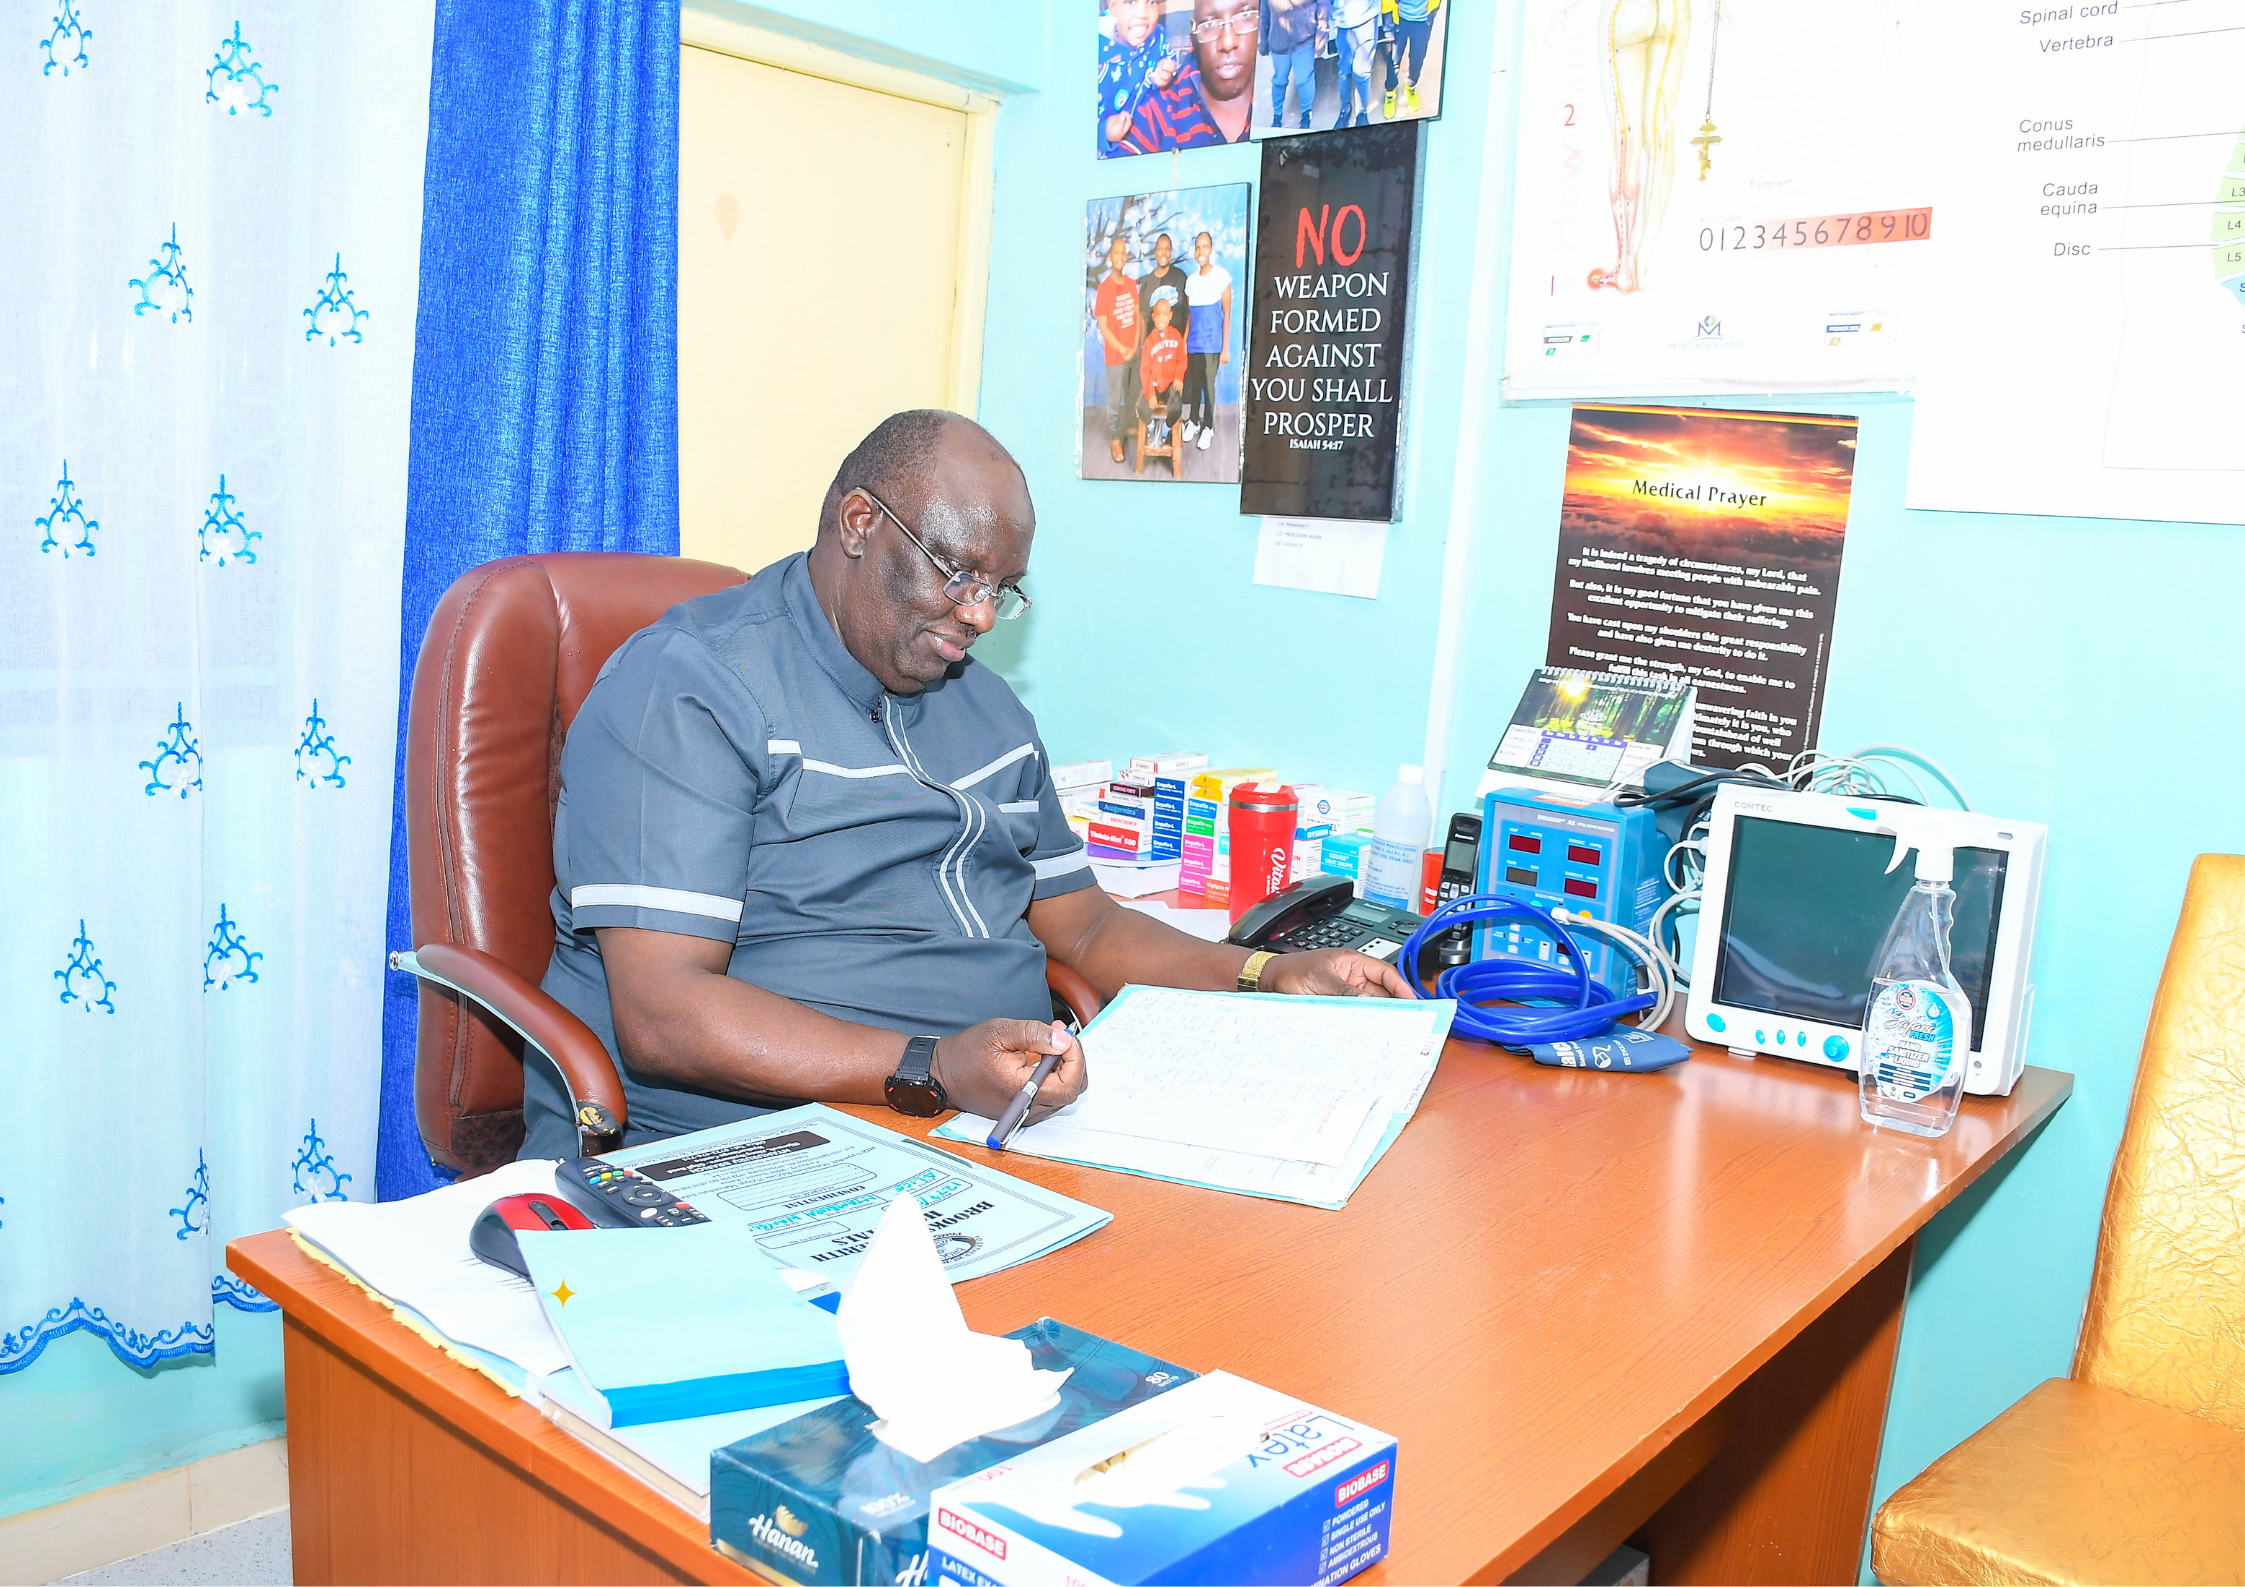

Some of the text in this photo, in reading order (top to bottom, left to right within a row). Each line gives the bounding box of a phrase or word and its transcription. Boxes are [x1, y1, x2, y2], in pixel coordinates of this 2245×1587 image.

[2020, 1, 2118, 26] Spinal cord
[2039, 35, 2114, 53] Vertebra
[1563, 103, 1576, 127] 2
[2019, 119, 2073, 133] Conus
[2017, 134, 2106, 152] medullaris
[1749, 178, 1793, 189] Treatment
[2042, 181, 2098, 197] Cauda
[2231, 187, 2245, 198] L3
[2040, 201, 2098, 218] equina
[1295, 203, 1366, 268] NO
[2227, 219, 2241, 231] L4
[2054, 242, 2091, 256] Disc
[2227, 251, 2241, 262] L5
[1274, 271, 1389, 299] WEAPON
[1270, 308, 1382, 334] FORMED
[1265, 343, 1382, 368] AGAINST
[1251, 378, 1393, 403] YOU SHALL
[1263, 411, 1374, 438] PROSPER
[1289, 438, 1343, 451] ISAIAH 54:17
[1633, 480, 1767, 509] Medical Prayer
[1568, 558, 1821, 595] my livelihood involves meeting people with unbearable pain.
[1583, 547, 1590, 556] It
[1591, 548, 1599, 557] is
[1600, 549, 1628, 560] indeed
[1636, 554, 1667, 566] tragedy
[1668, 558, 1679, 566] of
[1679, 559, 1744, 575] circumstances,
[1746, 568, 1760, 577] my
[1762, 568, 1785, 580] Lord,
[1787, 571, 1807, 581] that
[1570, 579, 1814, 619] But also, it is my good fortune that you have given me this
[1588, 595, 1788, 629] excellent opportunity to mitigate their suffering.
[1568, 612, 1582, 622] You
[1583, 615, 1602, 625] have
[1622, 622, 1643, 631] upon
[1644, 626, 1658, 634] my
[1659, 626, 1701, 639] shoulders
[1702, 632, 1719, 642] this
[1720, 636, 1744, 645] great
[1745, 640, 1807, 656] responsibility
[1597, 630, 1768, 661] and have also given me dexterity to do it.
[1569, 646, 1796, 689] Please grant me the strength, my God, to enable me to
[1631, 668, 1648, 677] this
[1679, 675, 1691, 684] all
[1692, 679, 1747, 693] earnestness.
[1732, 719, 1793, 737] it is you, who
[1746, 709, 1797, 726] faith in you
[1708, 738, 1742, 753] through
[1744, 746, 1771, 757] which
[1771, 752, 1793, 761] your
[1750, 734, 1781, 747] of well
[1734, 800, 1773, 813] CONTEC
[1898, 1040, 1921, 1051] HAND
[1909, 1030, 1936, 1043] FRESH
[1887, 1045, 1930, 1062] SANITIZER
[1893, 1055, 1920, 1068] LIQUID
[784, 1184, 866, 1209] CONFIDENTIAL
[1145, 1371, 1170, 1385] 80
[1288, 1439, 1358, 1477] BIOBASE
[1338, 1464, 1387, 1503] BIOBASE
[860, 1492, 911, 1514] 100%
[1332, 1498, 1369, 1527] POWDERED
[940, 1510, 1005, 1557] BIOBASE
[1331, 1501, 1386, 1541] SINGLE USE ONLY
[748, 1513, 819, 1568] Hanan
[1328, 1531, 1379, 1569] AMBIDEXTROUS
[1329, 1523, 1372, 1556] NON STERILE
[1349, 1543, 1382, 1570] GLOVES
[942, 1556, 977, 1584] LATEX
